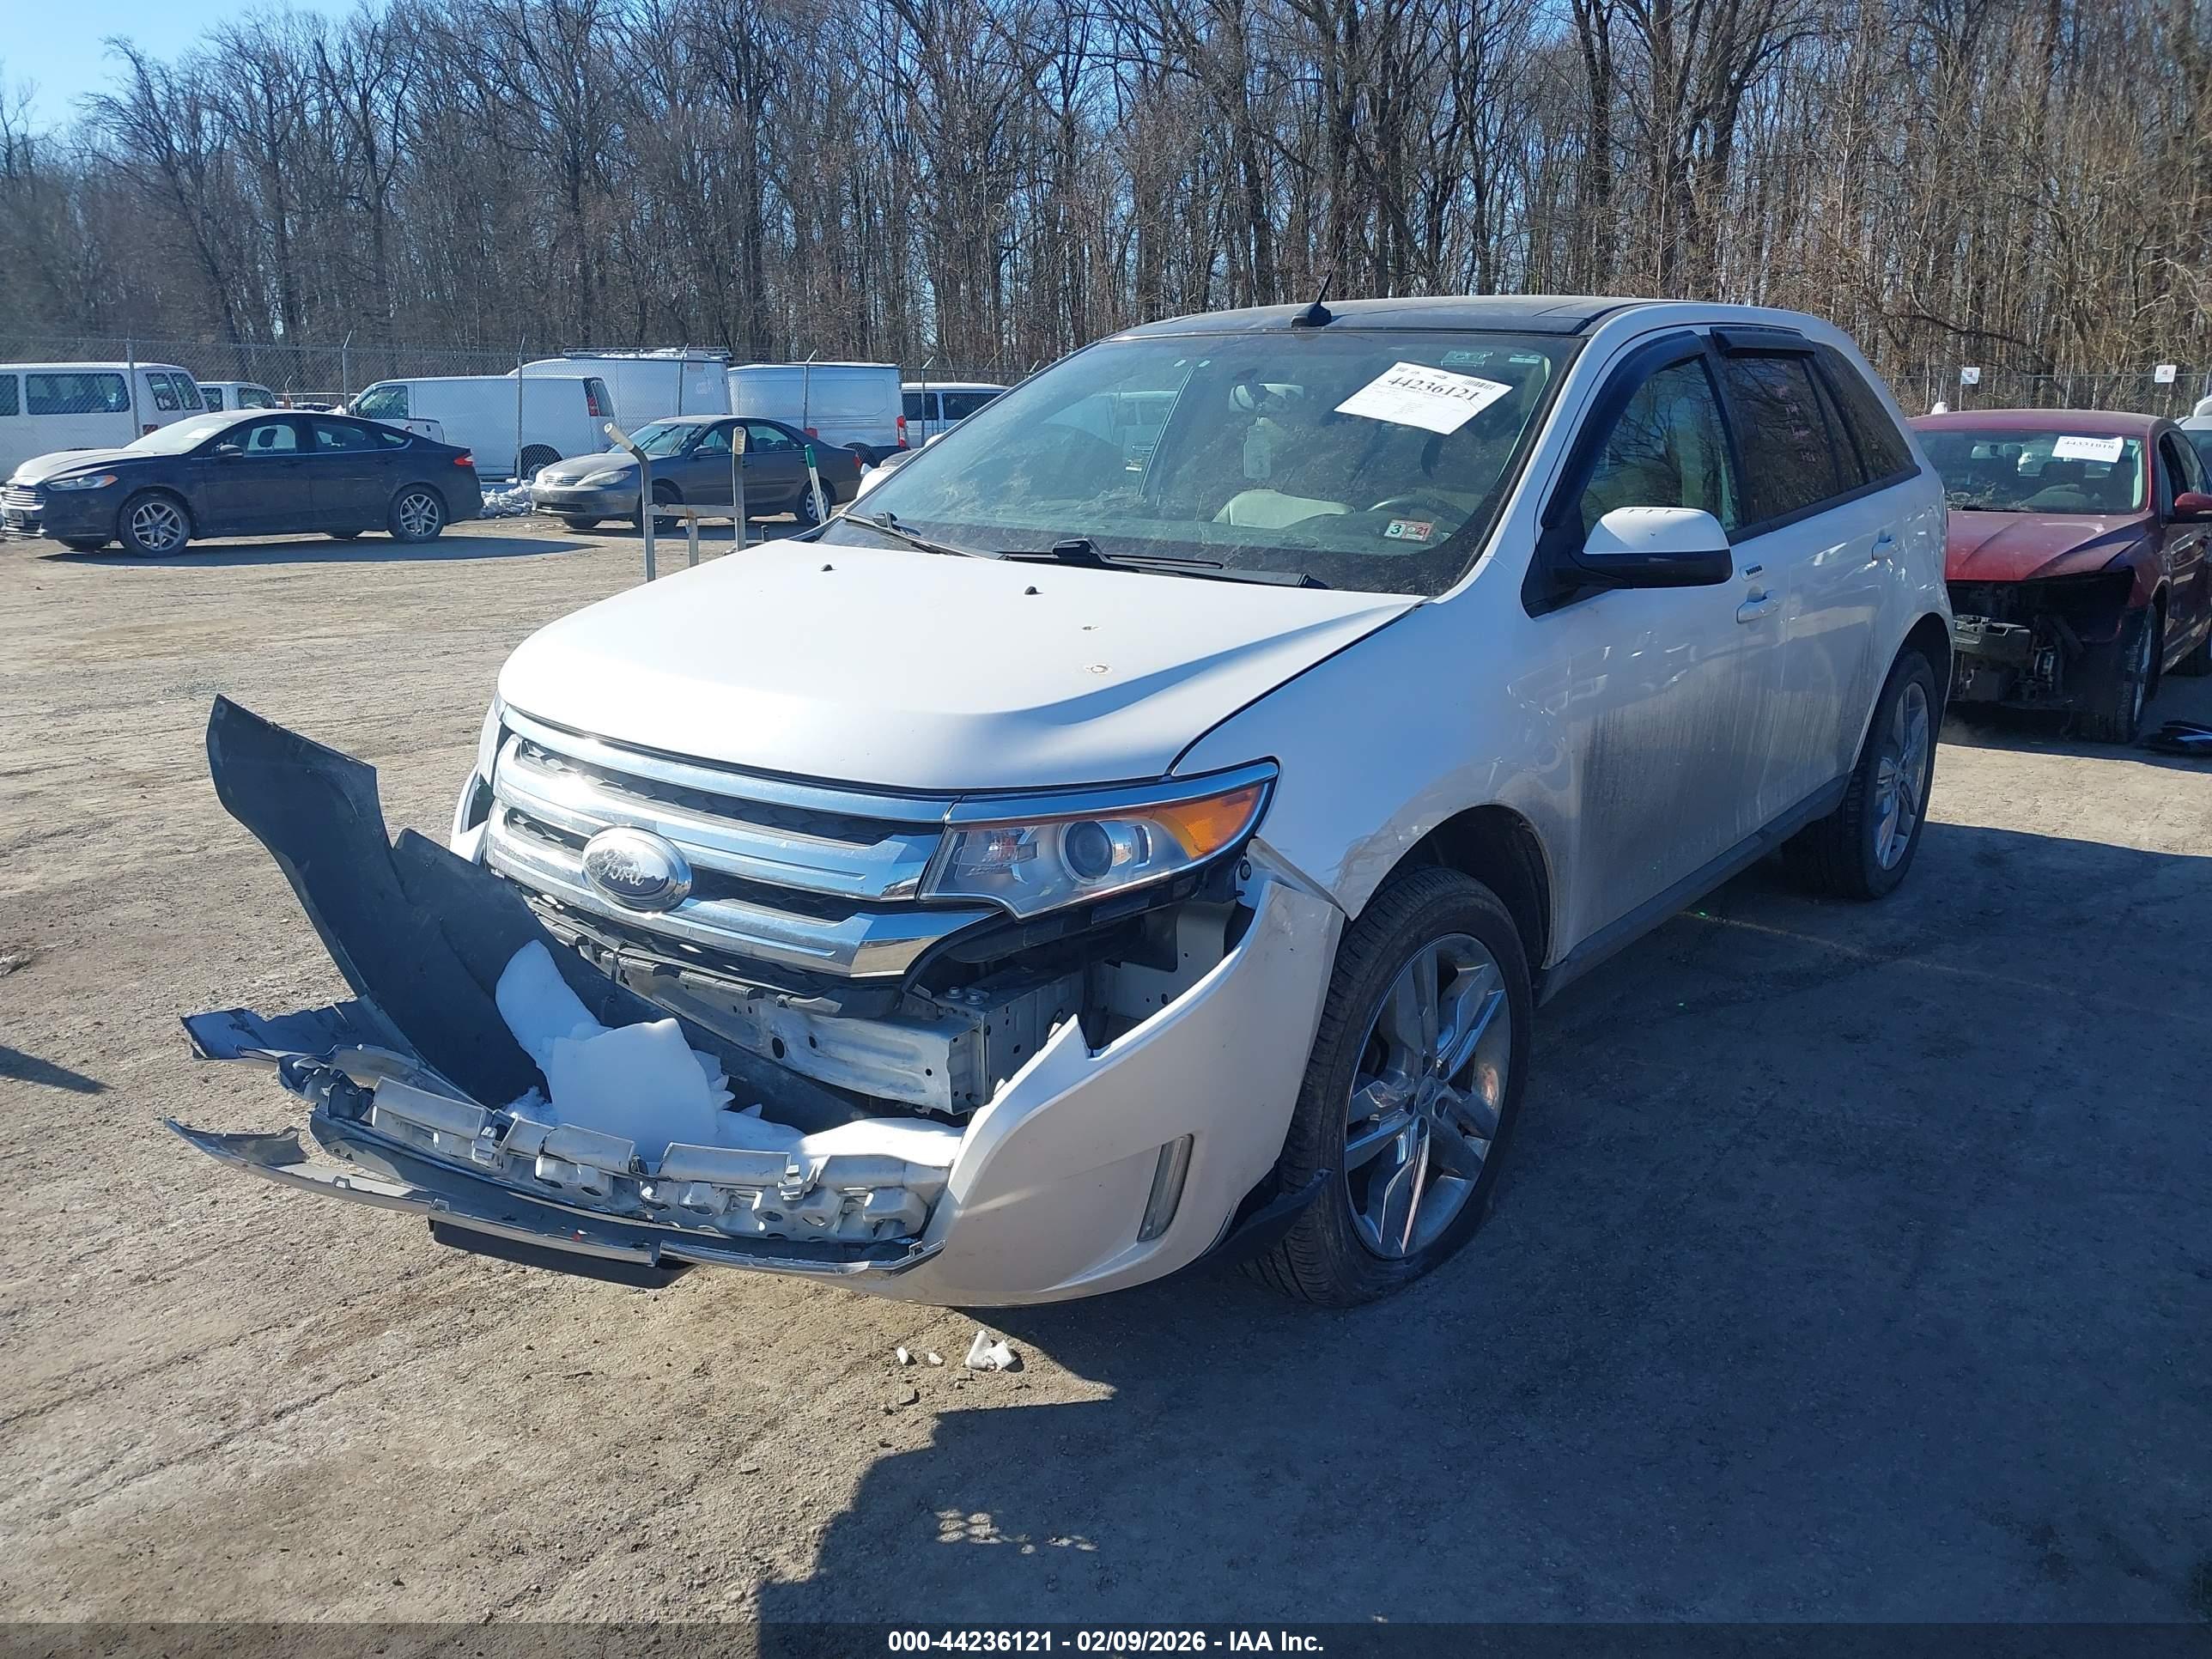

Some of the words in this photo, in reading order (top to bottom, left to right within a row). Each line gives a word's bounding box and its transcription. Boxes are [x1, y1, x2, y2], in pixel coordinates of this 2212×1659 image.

[1388, 377, 1480, 400] 44236121
[1390, 525, 1401, 534] 3
[599, 848, 645, 887] Ford
